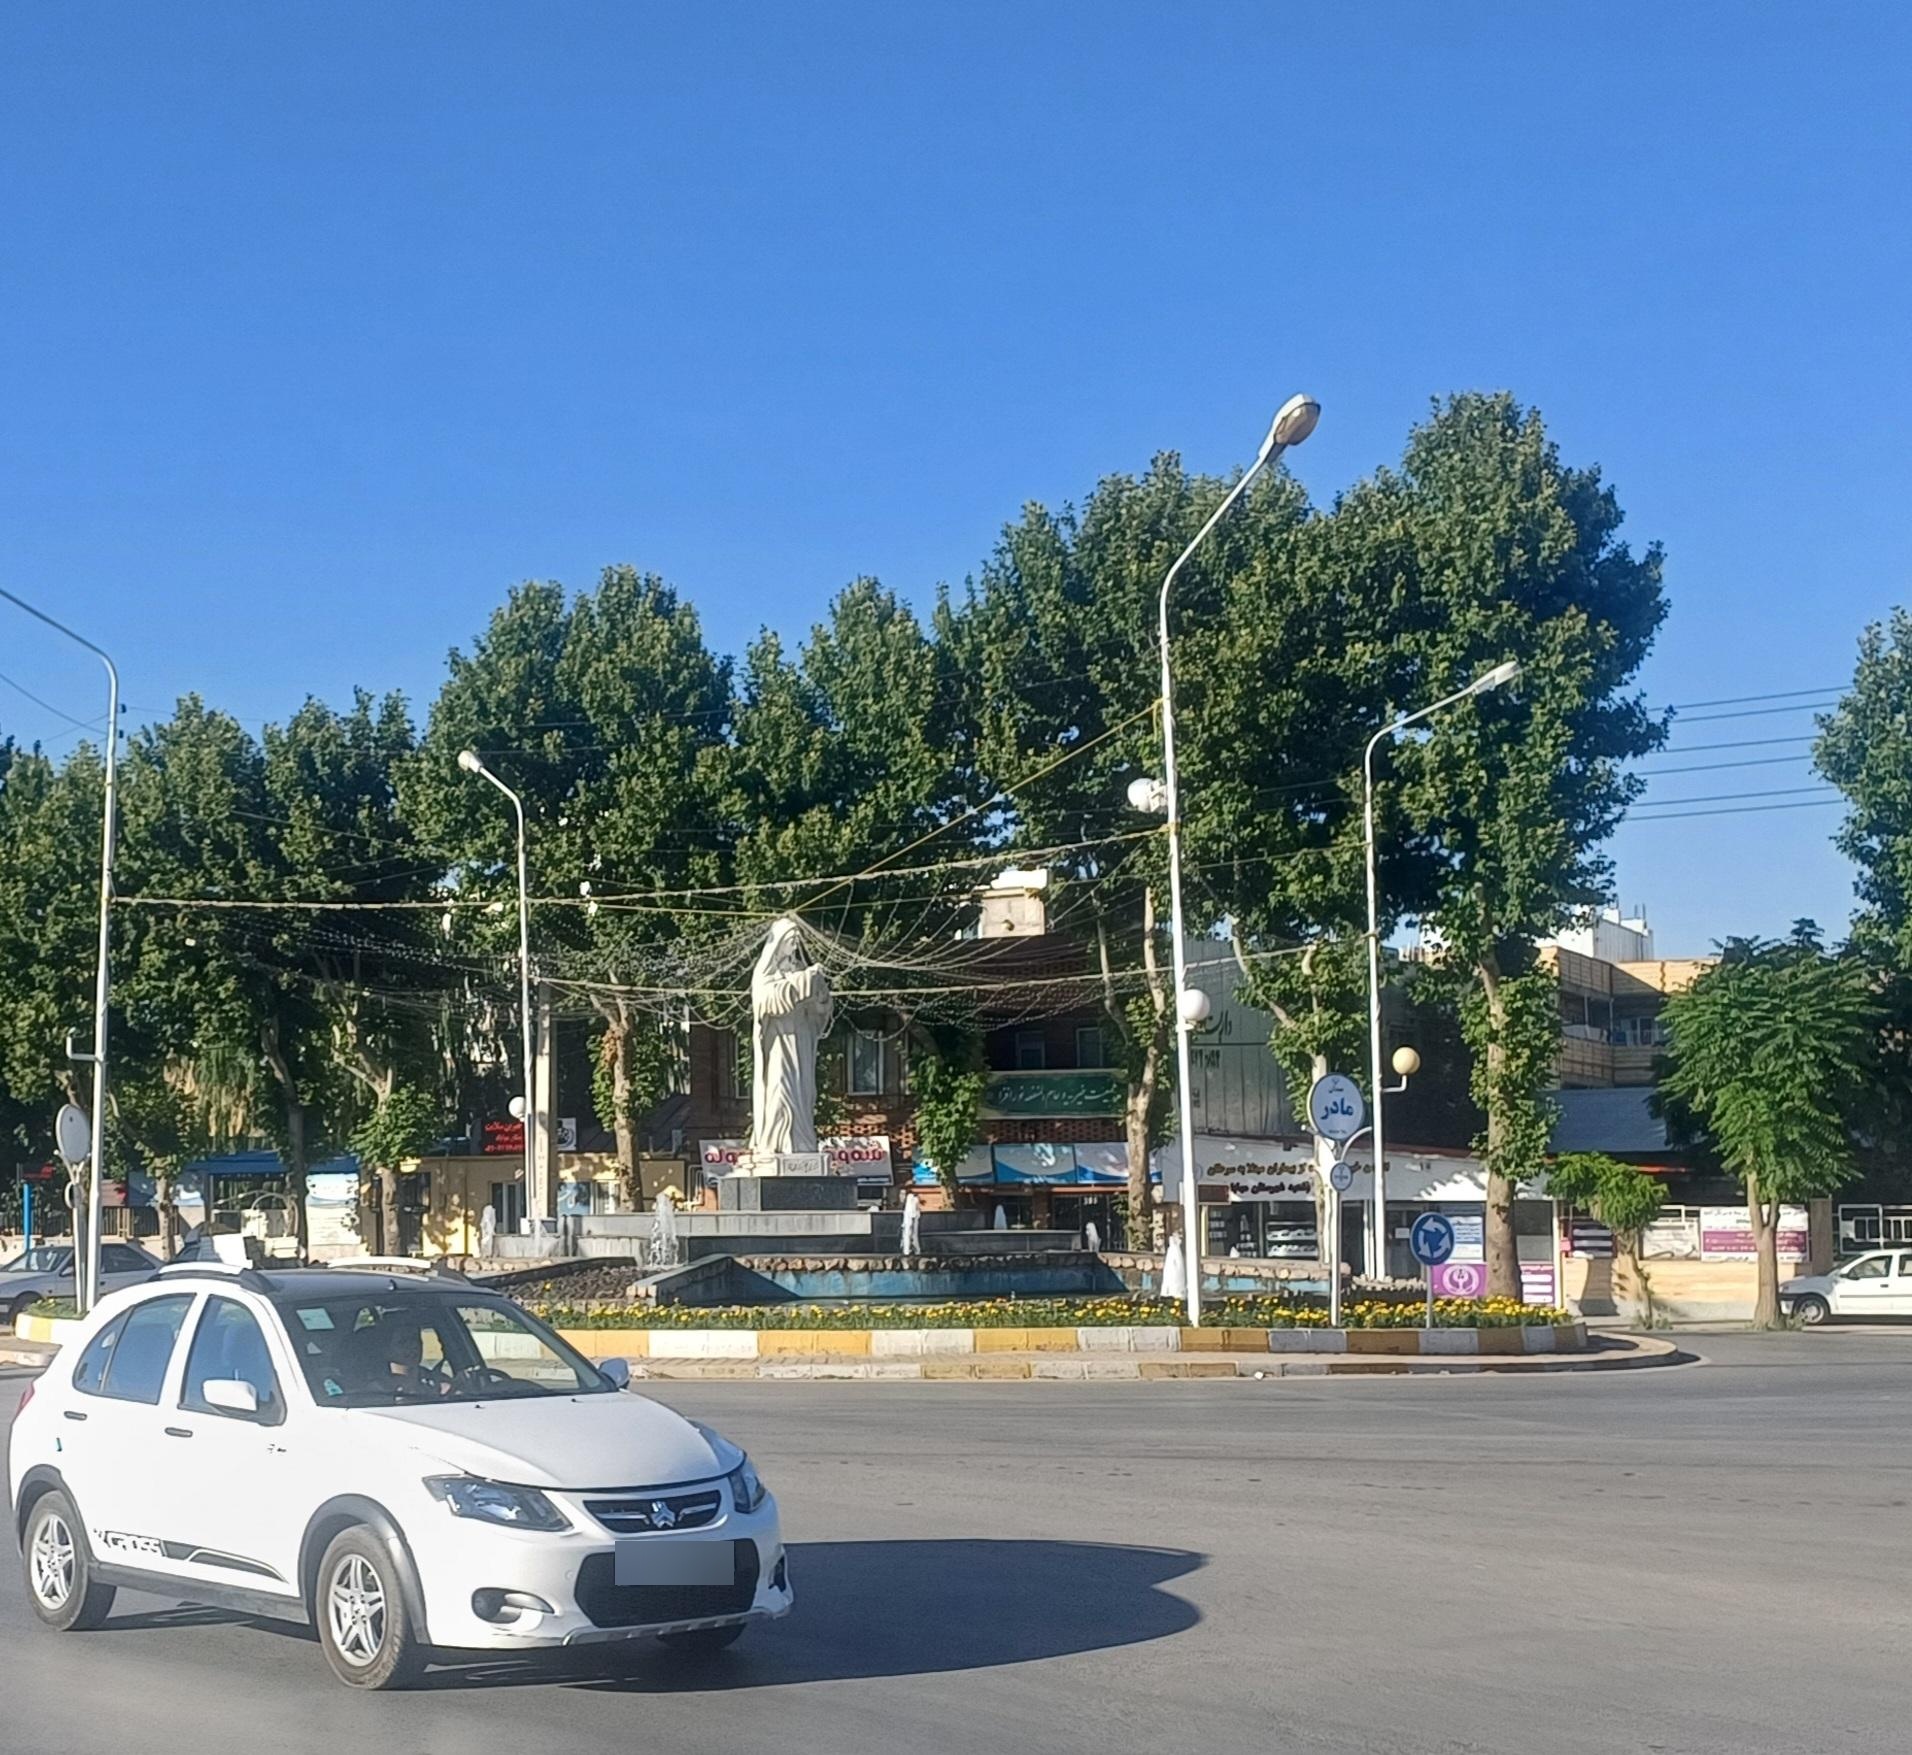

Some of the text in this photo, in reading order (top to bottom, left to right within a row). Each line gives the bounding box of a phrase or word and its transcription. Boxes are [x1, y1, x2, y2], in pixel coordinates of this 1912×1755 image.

[1320, 1097, 1354, 1120] مادر
[1246, 1162, 1266, 1176] مبتلا
[1266, 1162, 1296, 1177] بیماران
